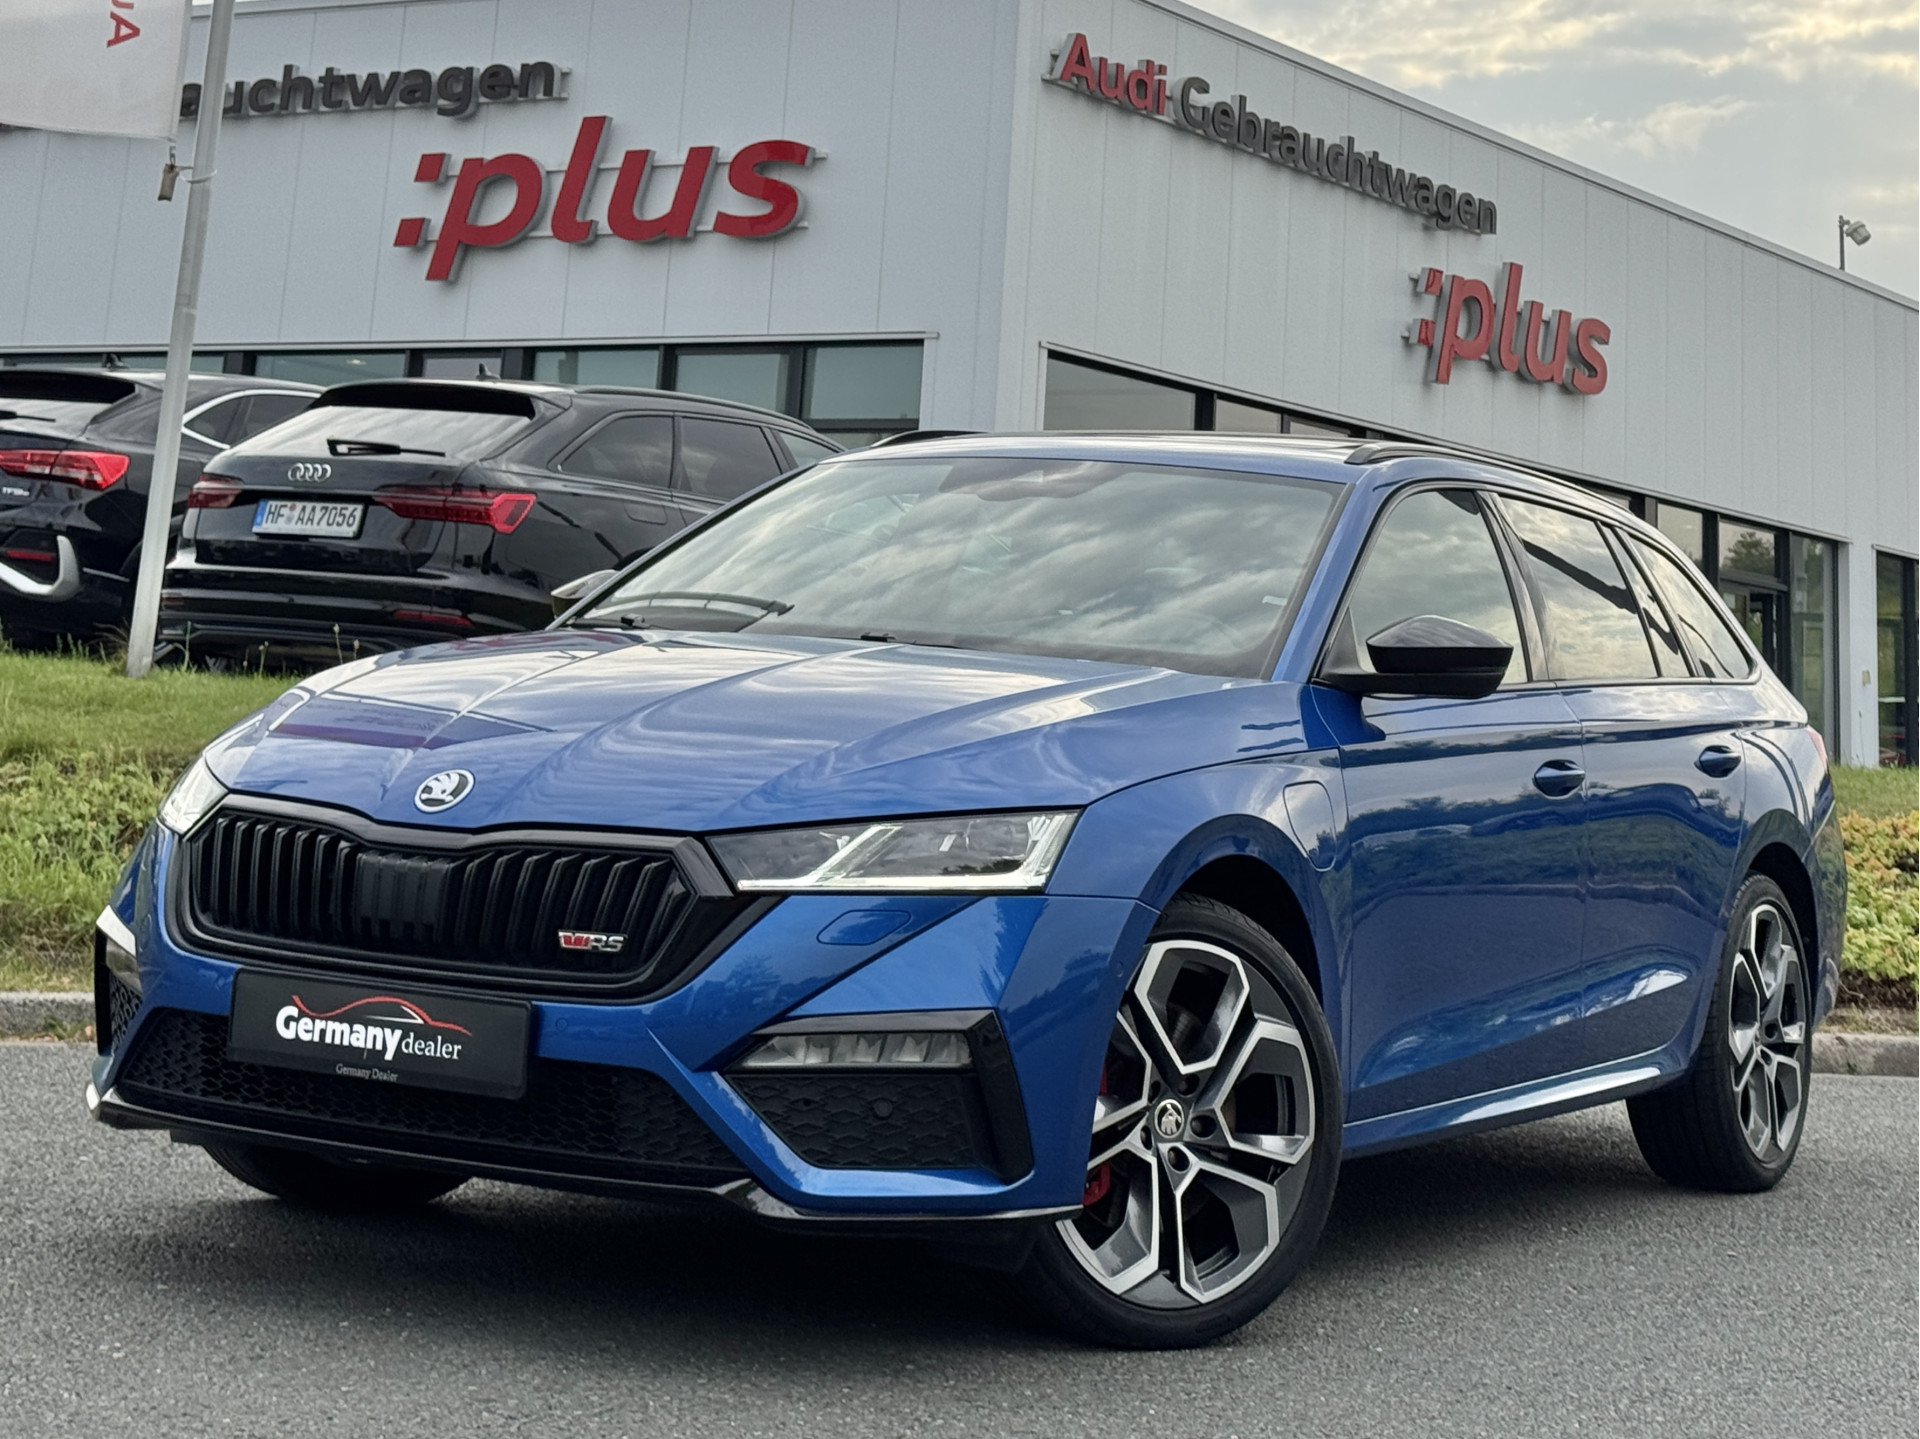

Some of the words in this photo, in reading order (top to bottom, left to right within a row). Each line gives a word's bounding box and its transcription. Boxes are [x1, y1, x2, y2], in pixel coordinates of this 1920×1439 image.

[1057, 32, 1168, 115] Audi
[1176, 76, 1497, 235] Gebrauchtwagen
[275, 1005, 402, 1061] Germany
[401, 1032, 462, 1060] dealer
[335, 1063, 371, 1079] Germany
[371, 1068, 399, 1082] Dealer
